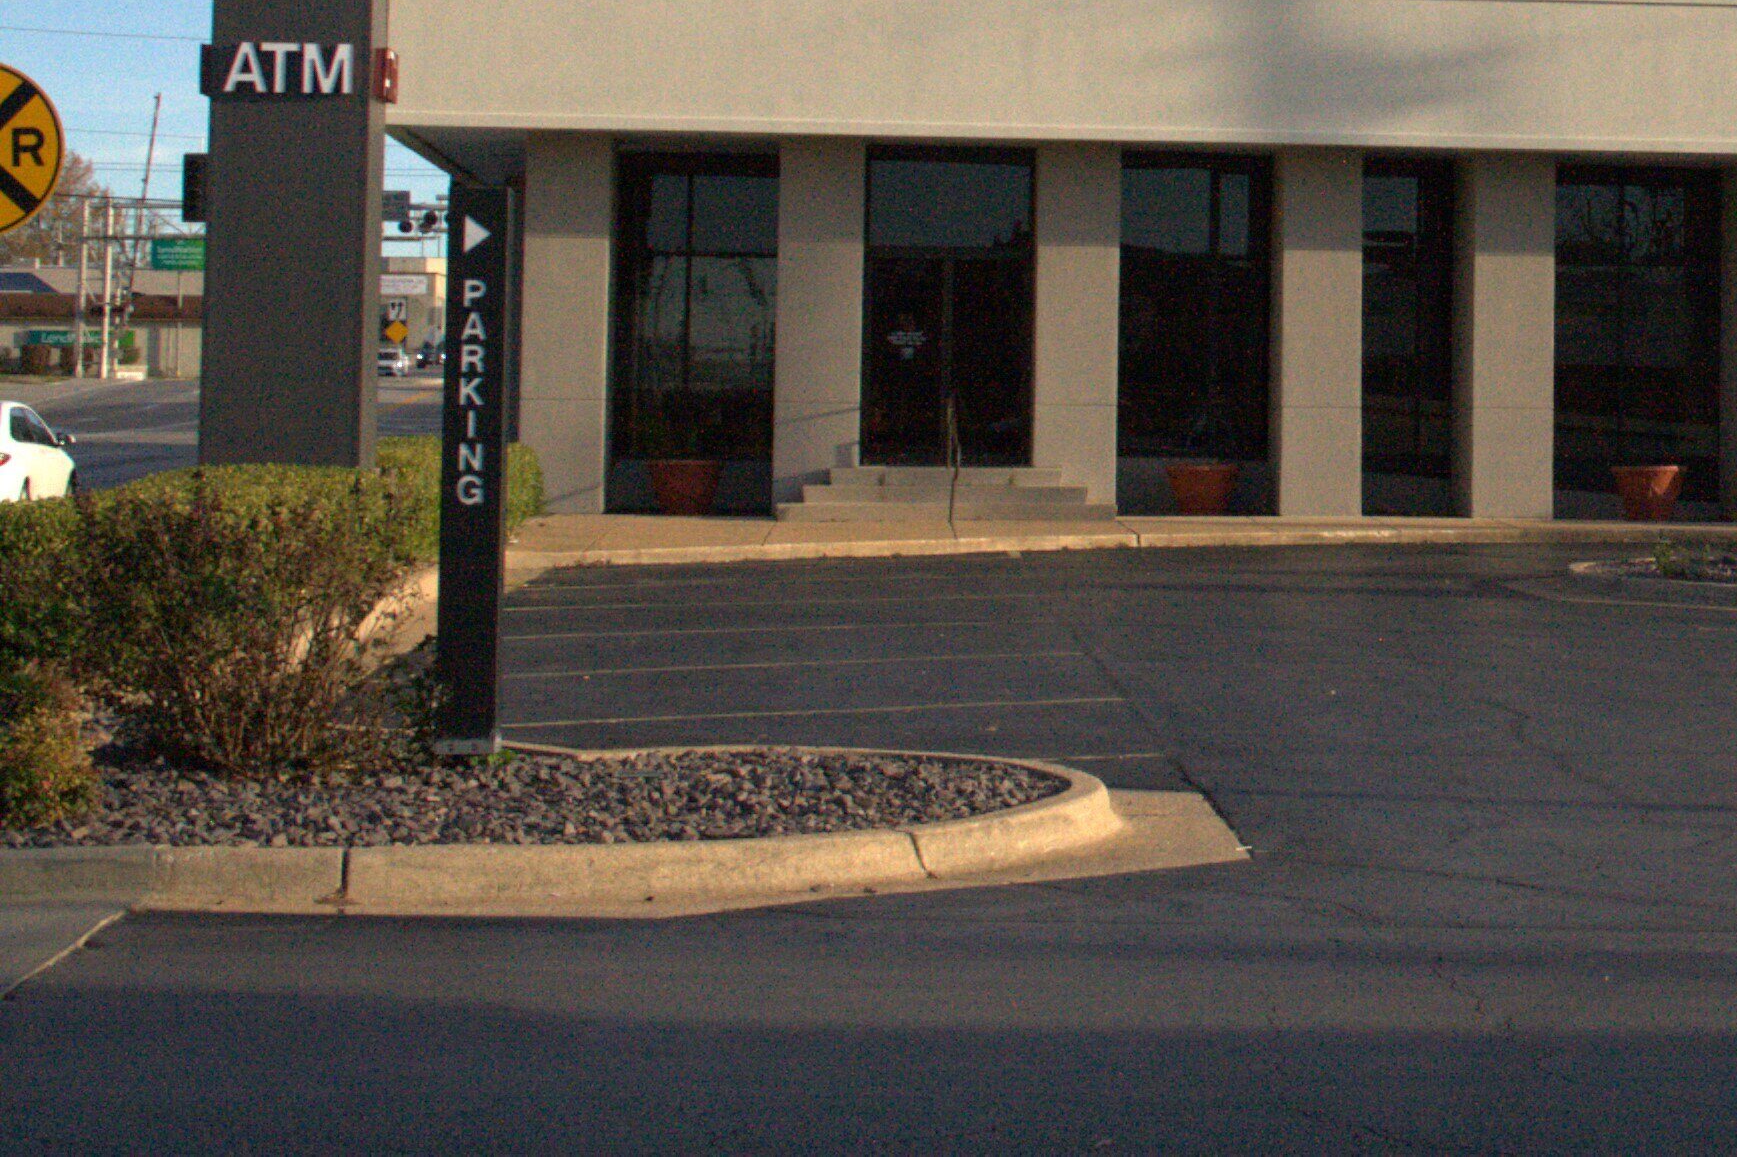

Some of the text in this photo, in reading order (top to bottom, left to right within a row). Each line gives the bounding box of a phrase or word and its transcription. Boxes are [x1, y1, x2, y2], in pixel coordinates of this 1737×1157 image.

[223, 42, 354, 94] ATM
[12, 127, 45, 167] R
[456, 279, 488, 505] PARKING
